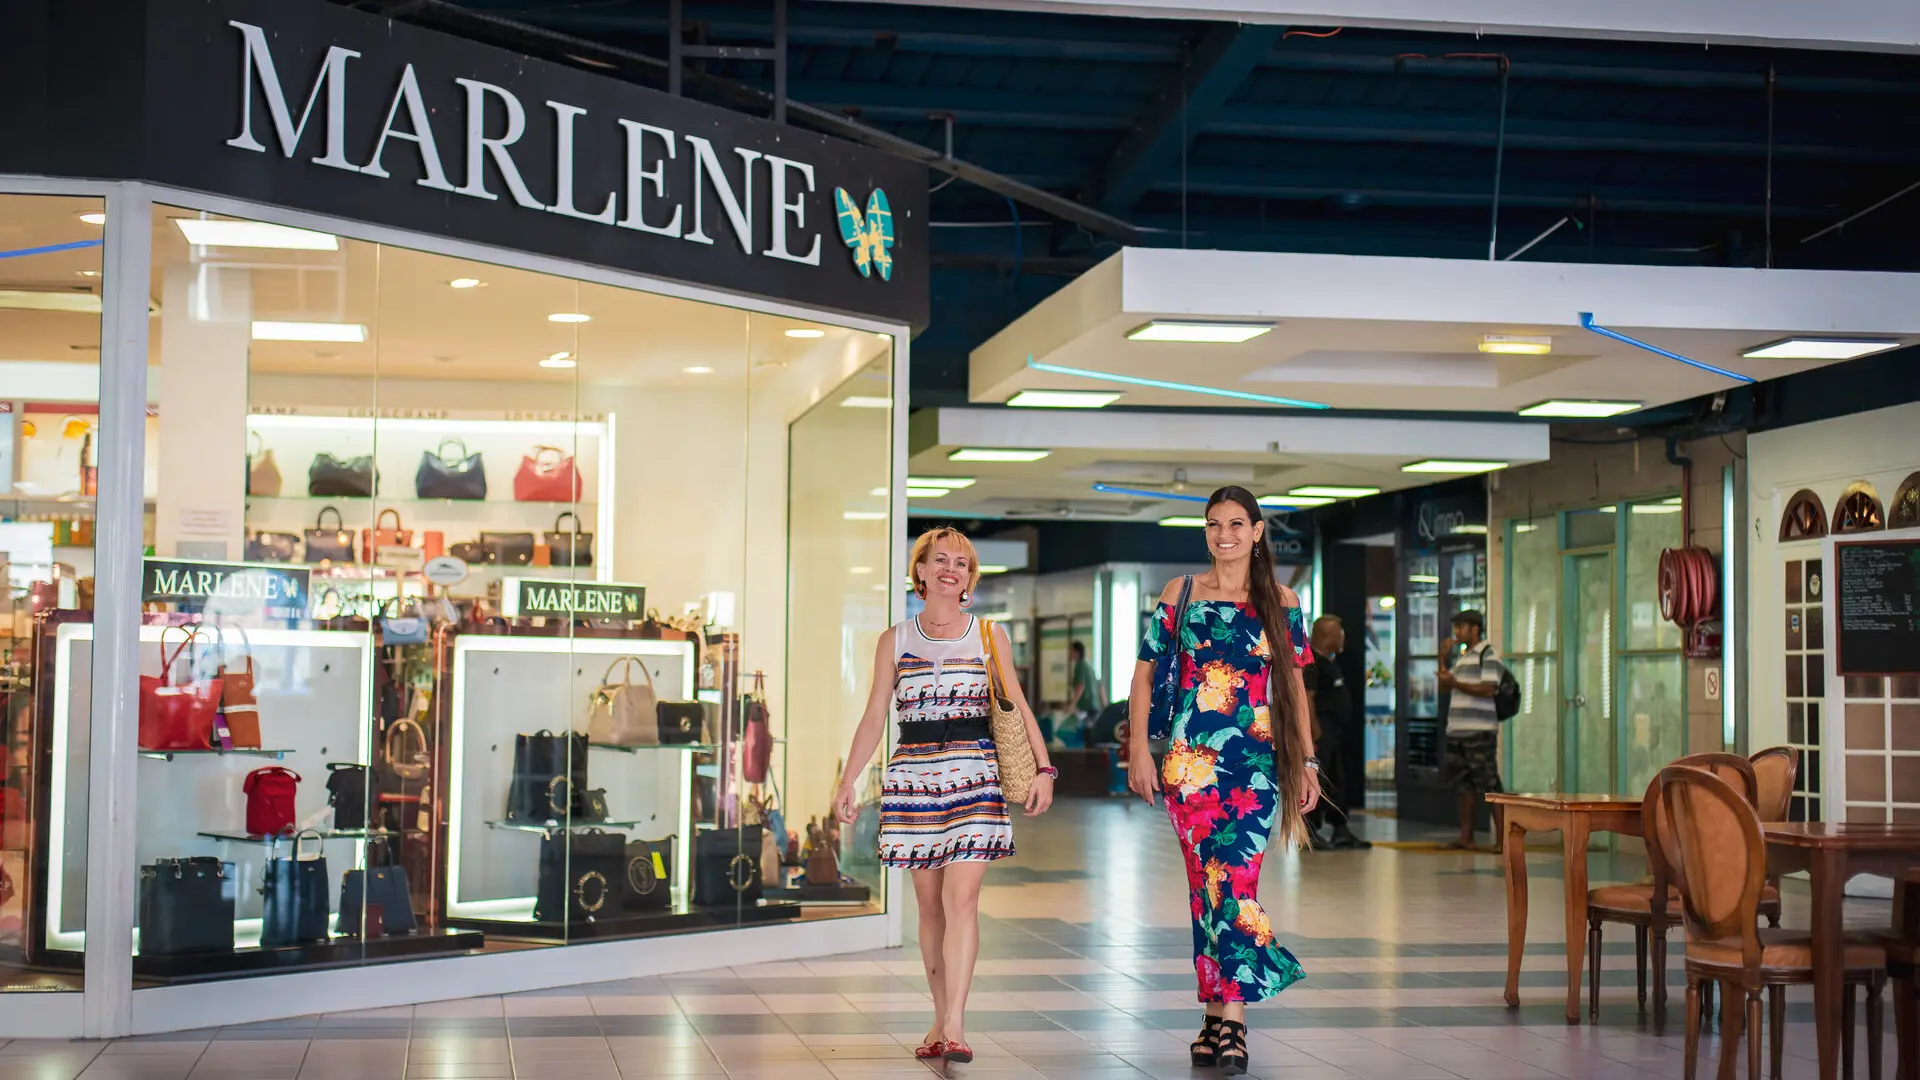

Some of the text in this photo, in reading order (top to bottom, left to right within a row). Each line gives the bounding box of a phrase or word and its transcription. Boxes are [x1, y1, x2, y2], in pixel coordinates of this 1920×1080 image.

[226, 19, 821, 266] MARLENE
[152, 568, 278, 599] MARLENE
[526, 587, 622, 613] MARLENE
